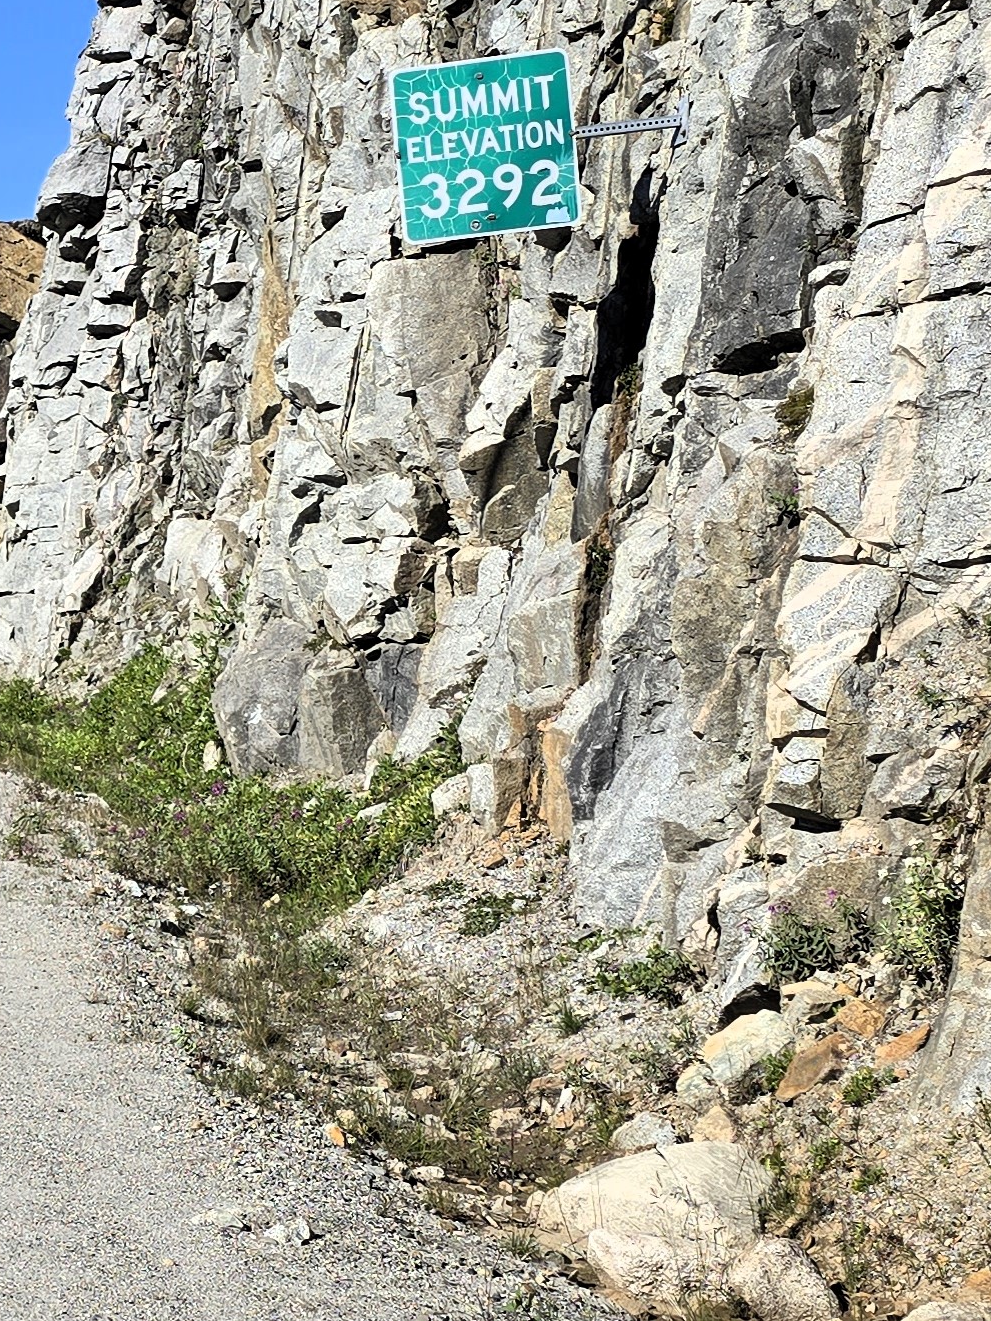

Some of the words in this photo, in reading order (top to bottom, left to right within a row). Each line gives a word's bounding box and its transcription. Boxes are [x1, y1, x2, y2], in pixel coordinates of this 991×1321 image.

[408, 75, 554, 125] SUMMIT
[407, 119, 565, 164] ELEVATION
[420, 159, 562, 219] 3292
